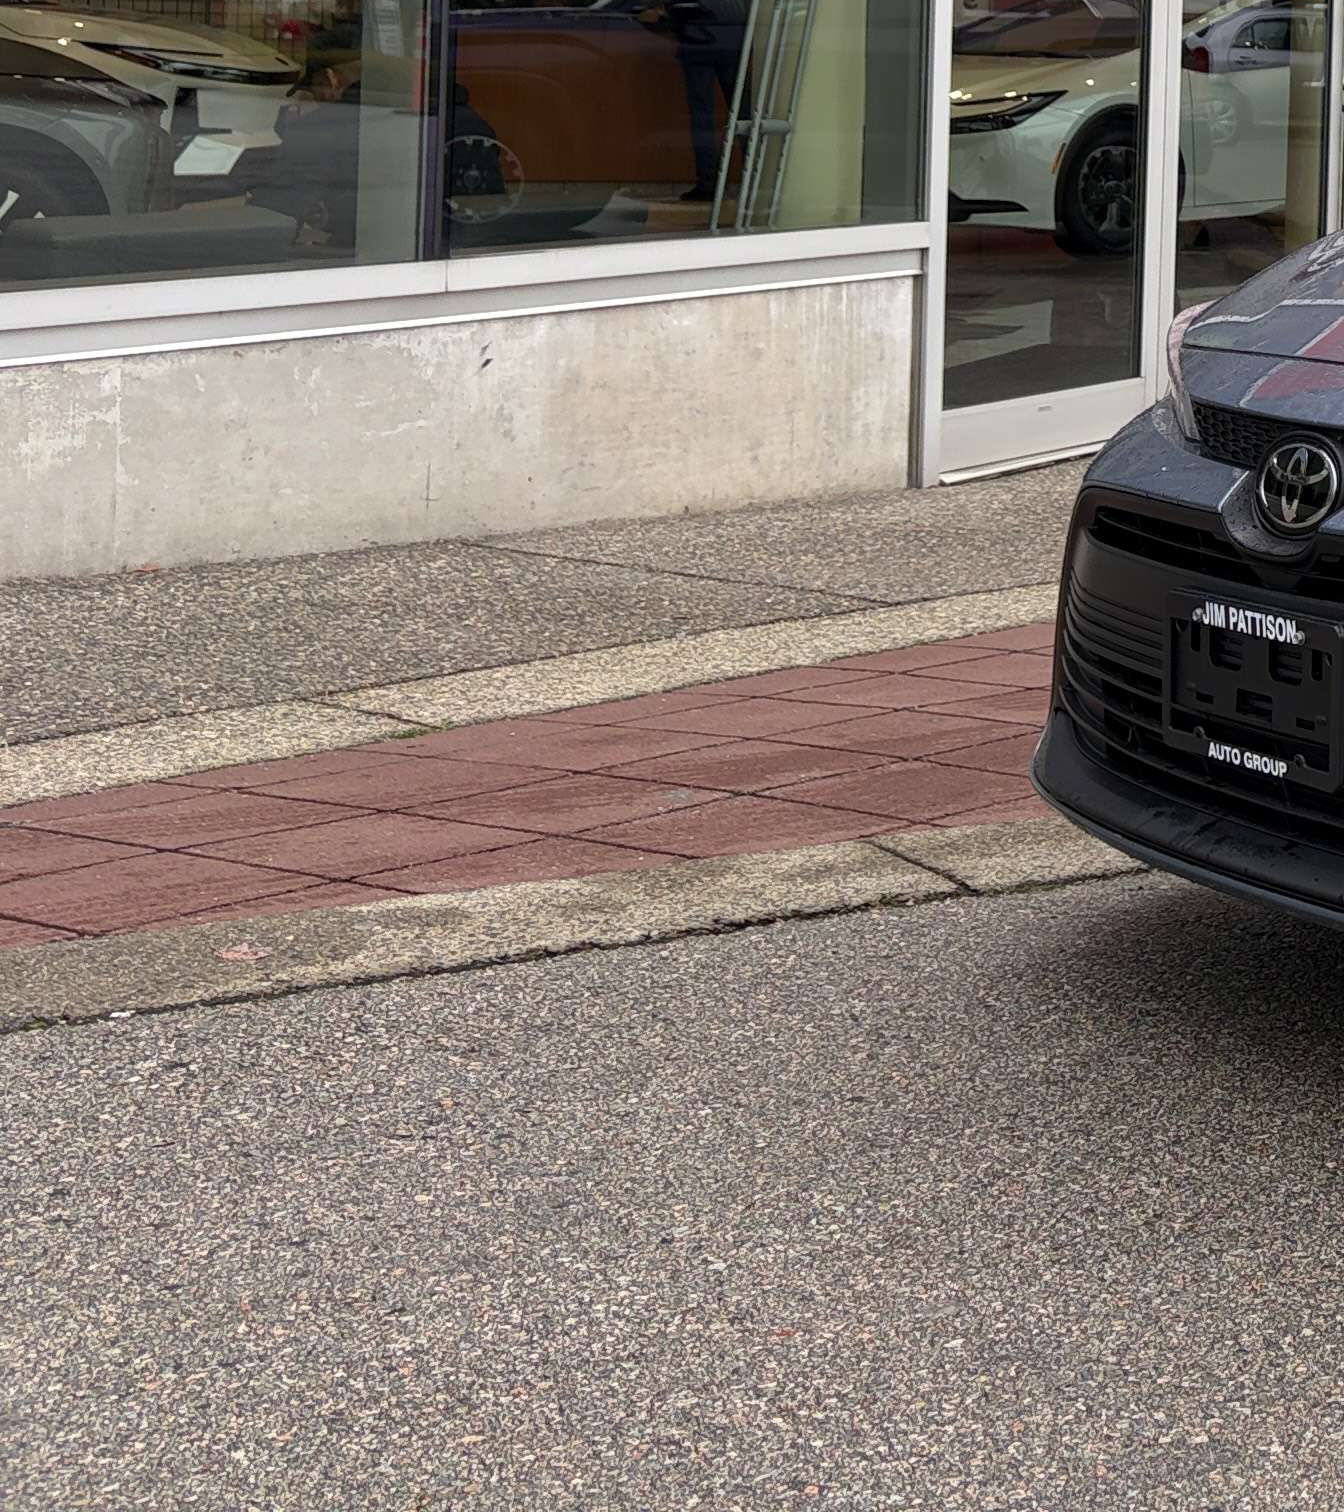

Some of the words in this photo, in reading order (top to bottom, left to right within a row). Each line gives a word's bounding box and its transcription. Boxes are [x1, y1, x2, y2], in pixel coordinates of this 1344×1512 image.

[1202, 601, 1226, 629] JIM
[1228, 606, 1298, 645] PATTISON
[1208, 741, 1241, 766] AUTO
[1243, 751, 1288, 778] GROUP
